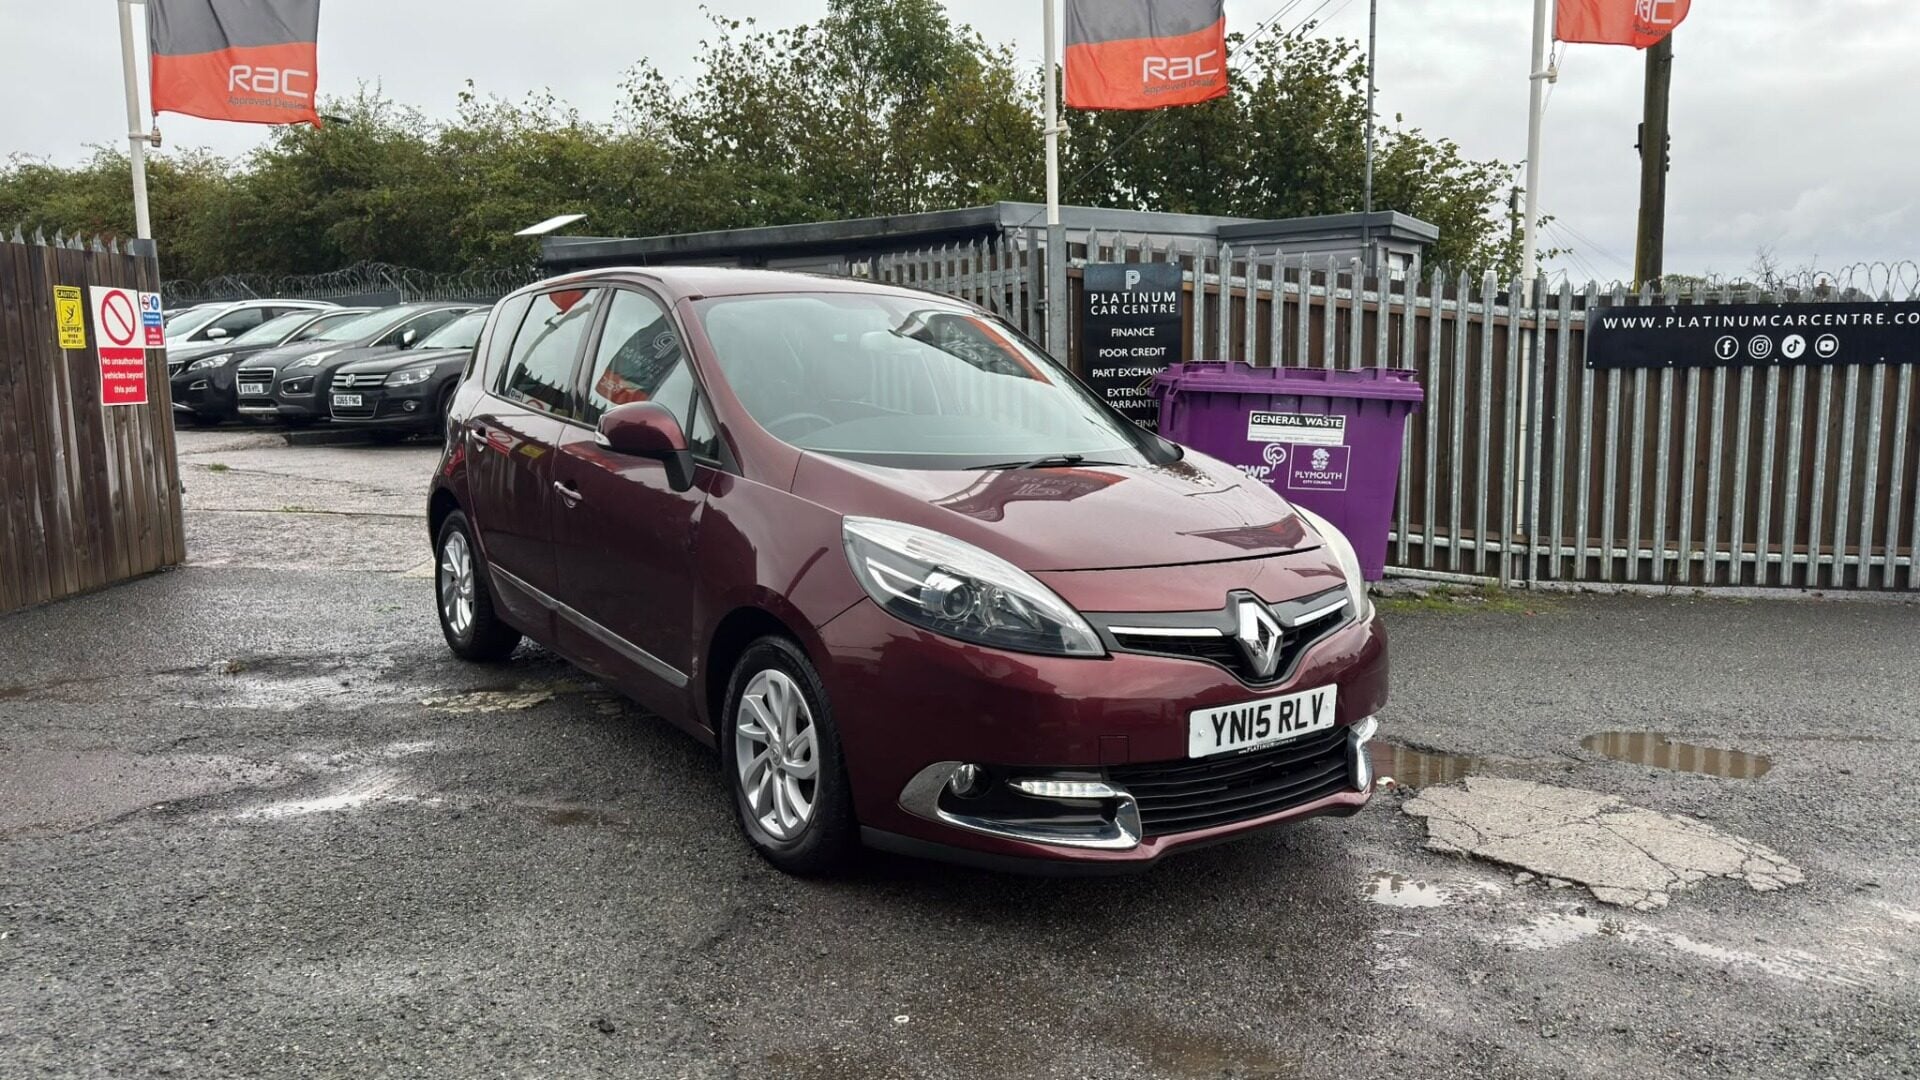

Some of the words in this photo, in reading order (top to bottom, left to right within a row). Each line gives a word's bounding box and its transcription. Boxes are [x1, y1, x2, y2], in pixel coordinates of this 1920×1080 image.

[1143, 81, 1187, 95] Approved
[228, 95, 272, 106] Approved
[1090, 291, 1176, 304] PLATINUM
[1090, 305, 1118, 315] CAR
[1122, 303, 1176, 314] CENTRE
[1111, 327, 1155, 337] FINANCE
[1099, 348, 1128, 357] POOR
[1131, 347, 1167, 357] CREDIT
[102, 357, 110, 366] No
[104, 371, 126, 379] vehicles
[126, 371, 144, 381] beyond
[1092, 369, 1116, 377] PART
[114, 385, 125, 393] this
[125, 385, 137, 394] point
[1252, 414, 1303, 426] GENERAL
[1304, 416, 1343, 428] WASTE
[1294, 470, 1342, 480] PLYMOUTH
[1211, 704, 1272, 747] YN15
[1278, 692, 1325, 734] RLV
